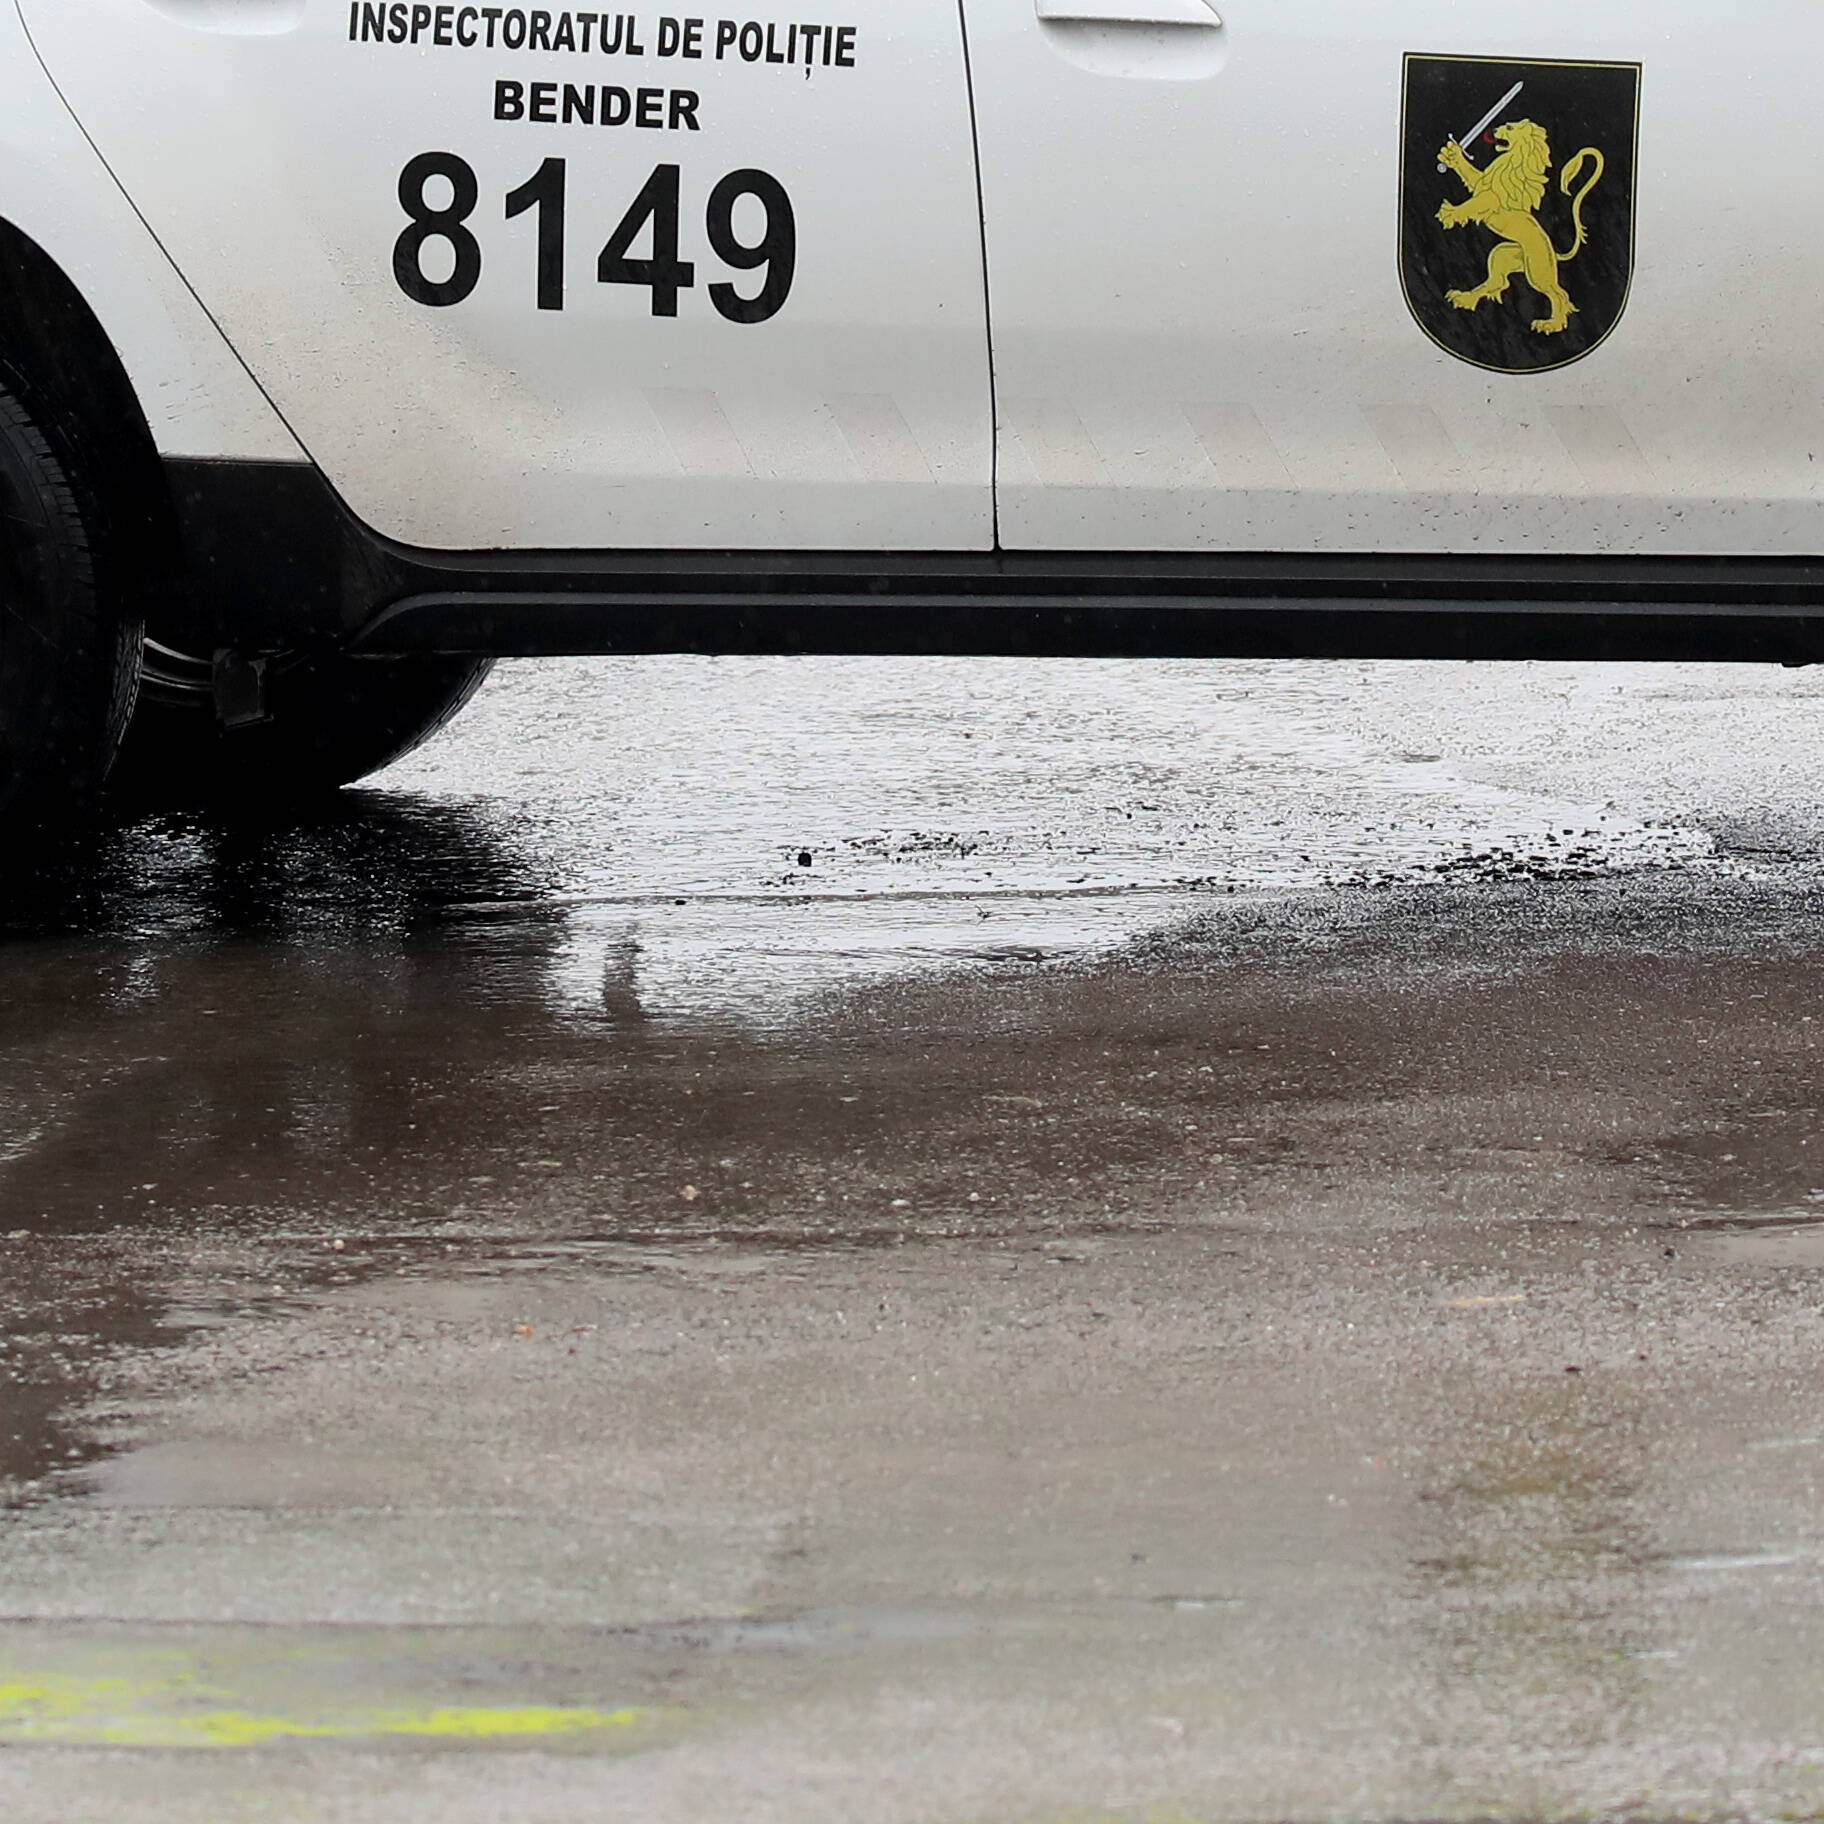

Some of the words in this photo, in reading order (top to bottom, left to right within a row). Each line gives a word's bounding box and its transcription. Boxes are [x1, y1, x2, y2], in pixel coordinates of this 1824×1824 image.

[349, 1, 644, 56] INSPECTORATUL
[657, 17, 704, 59] DE
[715, 20, 857, 81] POLIȚIE
[493, 79, 701, 131] BENDER
[392, 151, 796, 325] 8149
